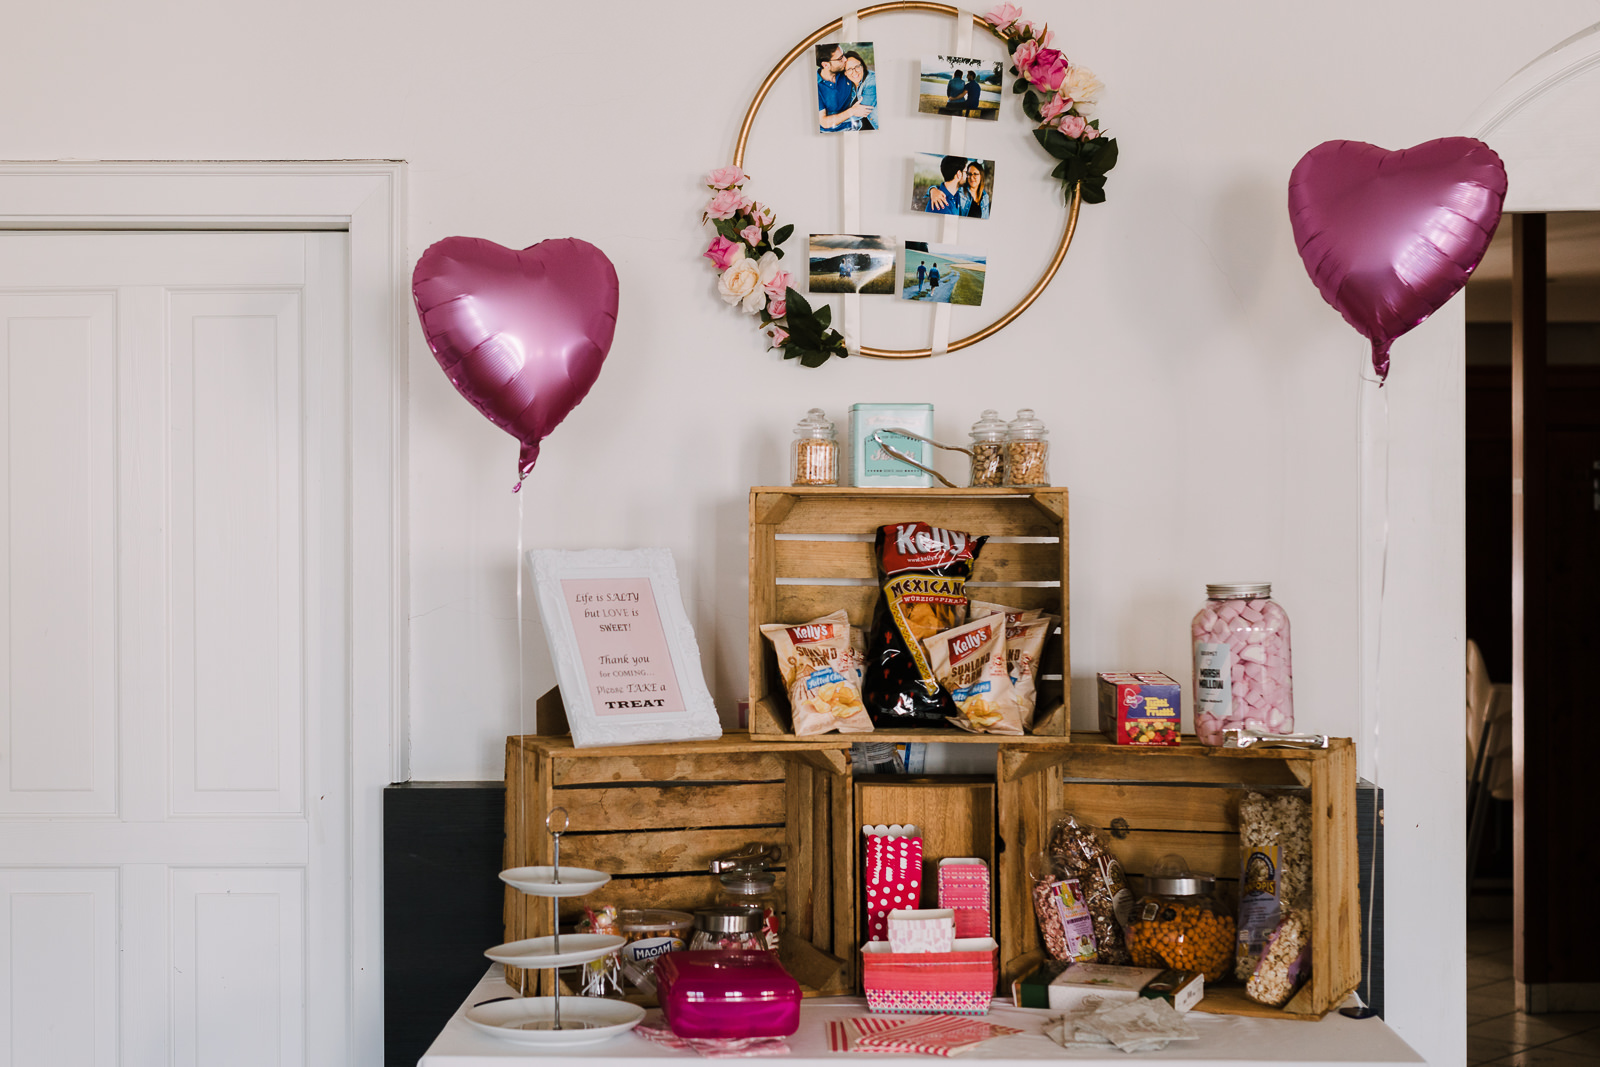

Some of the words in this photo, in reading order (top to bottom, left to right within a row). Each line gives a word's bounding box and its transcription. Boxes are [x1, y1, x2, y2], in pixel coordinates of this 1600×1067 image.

[575, 592, 593, 605] Life
[596, 593, 604, 602] is
[606, 592, 639, 603] SALTY
[903, 595, 934, 603] WÜRZIG
[584, 608, 599, 618] but
[602, 608, 629, 618] LOVE
[631, 608, 639, 617] is
[599, 623, 631, 632] SWEET!
[792, 625, 828, 640] Kelly's
[952, 629, 988, 656] Kelly's
[598, 654, 629, 665] Thank
[632, 656, 650, 667] you
[951, 652, 991, 678] SUNLAND
[599, 670, 611, 678] for
[1199, 669, 1221, 678] MARSH
[596, 685, 624, 696] Please
[626, 683, 657, 693] TAKE
[660, 684, 666, 692] a
[1198, 679, 1224, 690] MALLOW
[604, 699, 665, 709] TREAT
[1144, 697, 1170, 707] Tutti
[1144, 706, 1176, 717] Frutti
[635, 943, 671, 960] MAOAM
